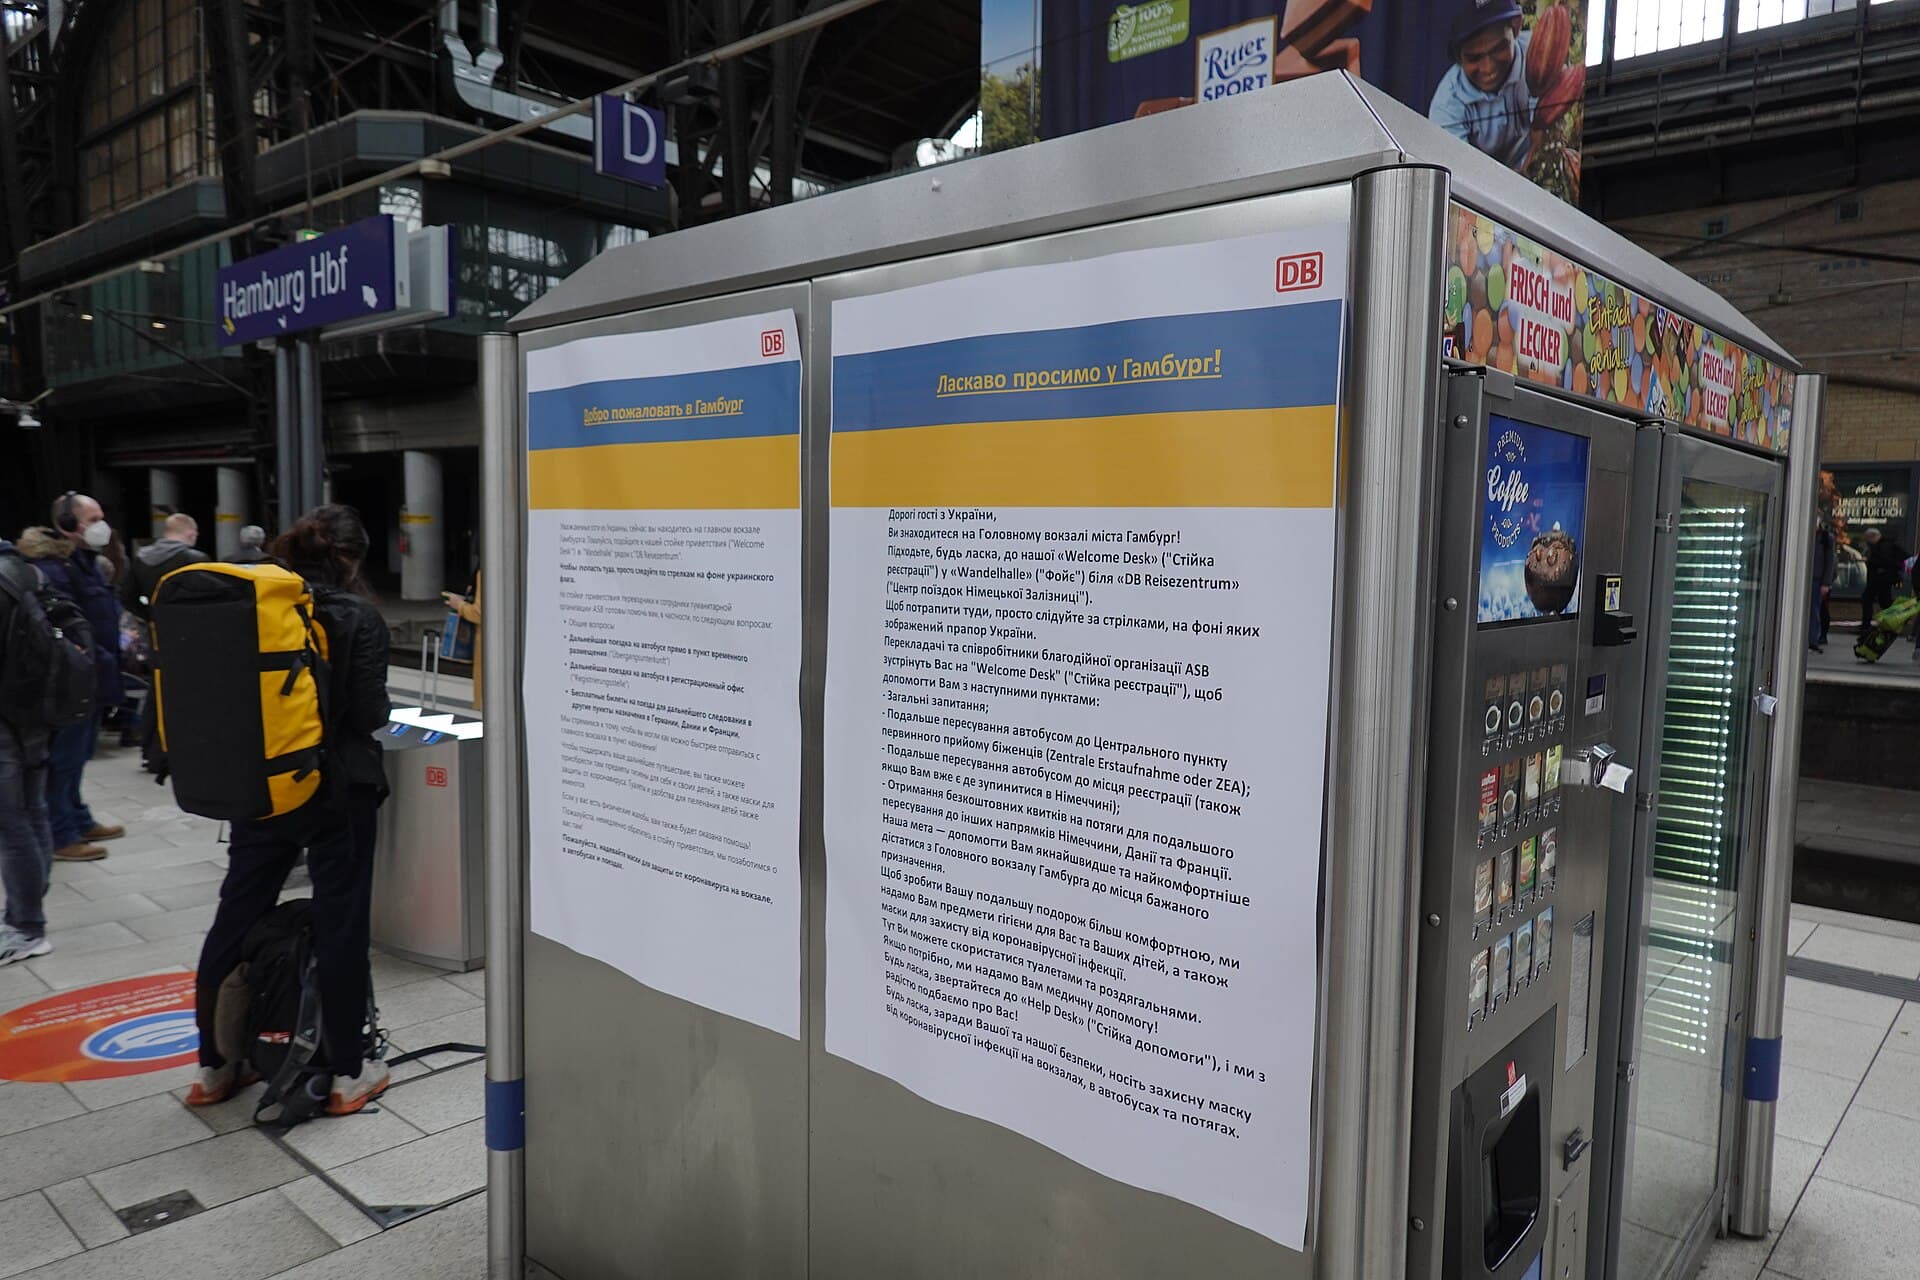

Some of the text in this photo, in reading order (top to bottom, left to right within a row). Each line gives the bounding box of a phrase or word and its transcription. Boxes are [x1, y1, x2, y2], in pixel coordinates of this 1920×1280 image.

[1204, 36, 1268, 82] Ritter
[1203, 73, 1268, 102] SPORT
[622, 101, 658, 165] D
[223, 244, 349, 319] Hamburg Hbf
[1280, 257, 1319, 289] DB
[1509, 263, 1573, 323] FRISCH und
[1587, 294, 1632, 335] Einfach
[763, 332, 783, 354] DB
[1519, 318, 1562, 366] LECKER
[936, 348, 1222, 394] Ласкаво просимо у Гамбург!
[1703, 352, 1735, 390] FRISCH und
[583, 396, 745, 424] Добро пожаловать в Гамбург
[1706, 391, 1728, 420] LECKER
[1497, 430, 1526, 457] PREMIUM
[1487, 464, 1529, 512] Coffee
[887, 507, 997, 523] Дорогі гості з України,
[887, 526, 1181, 547] Ви знаходитеся на Головному вокзалі міста Гамбург!
[1491, 521, 1522, 549] PRODUCTS
[886, 544, 1215, 569] Підходьте, будь ласка, до нашої «Welcome Desk» ("Стійка
[696, 570, 774, 583] на фоне украинского
[886, 563, 1240, 591] реєстрації") у «Wandelhalle» ("Фойє") біля «DB Reisezentrum»
[885, 580, 1093, 607] ("Центр поїздок Німецької Залізниці").
[885, 599, 1260, 638] Щоб потрапити туди, просто слідуйте за стрілками, на фоні яких
[608, 639, 632, 648] поездка
[632, 641, 640, 649] на
[640, 641, 666, 653] автобусе
[666, 645, 686, 655] прямо
[692, 648, 710, 658] пункт
[883, 634, 1210, 678] Перекладачі та співробітники благодійної організації ASB
[608, 667, 632, 676] поездка
[640, 671, 665, 682] автобусе
[726, 682, 744, 694] офис
[428, 769, 445, 786] DB
[880, 726, 1251, 798] первинного прийому біженців (Zentrale Erstaufnahme oder ZEA);
[683, 873, 773, 905] коронавируса на вокзале,
[882, 917, 1202, 1024] Тут Ви можете скористатися туалетами та роздягальнями.
[883, 952, 1266, 1083] Будь ласка, звертайтеся до «Help Desk» ("Стійка допомоги"), і ми з
[885, 986, 1252, 1124] Будь ласка, заради Вашої та нашої безпеки, носіть захисну маску
